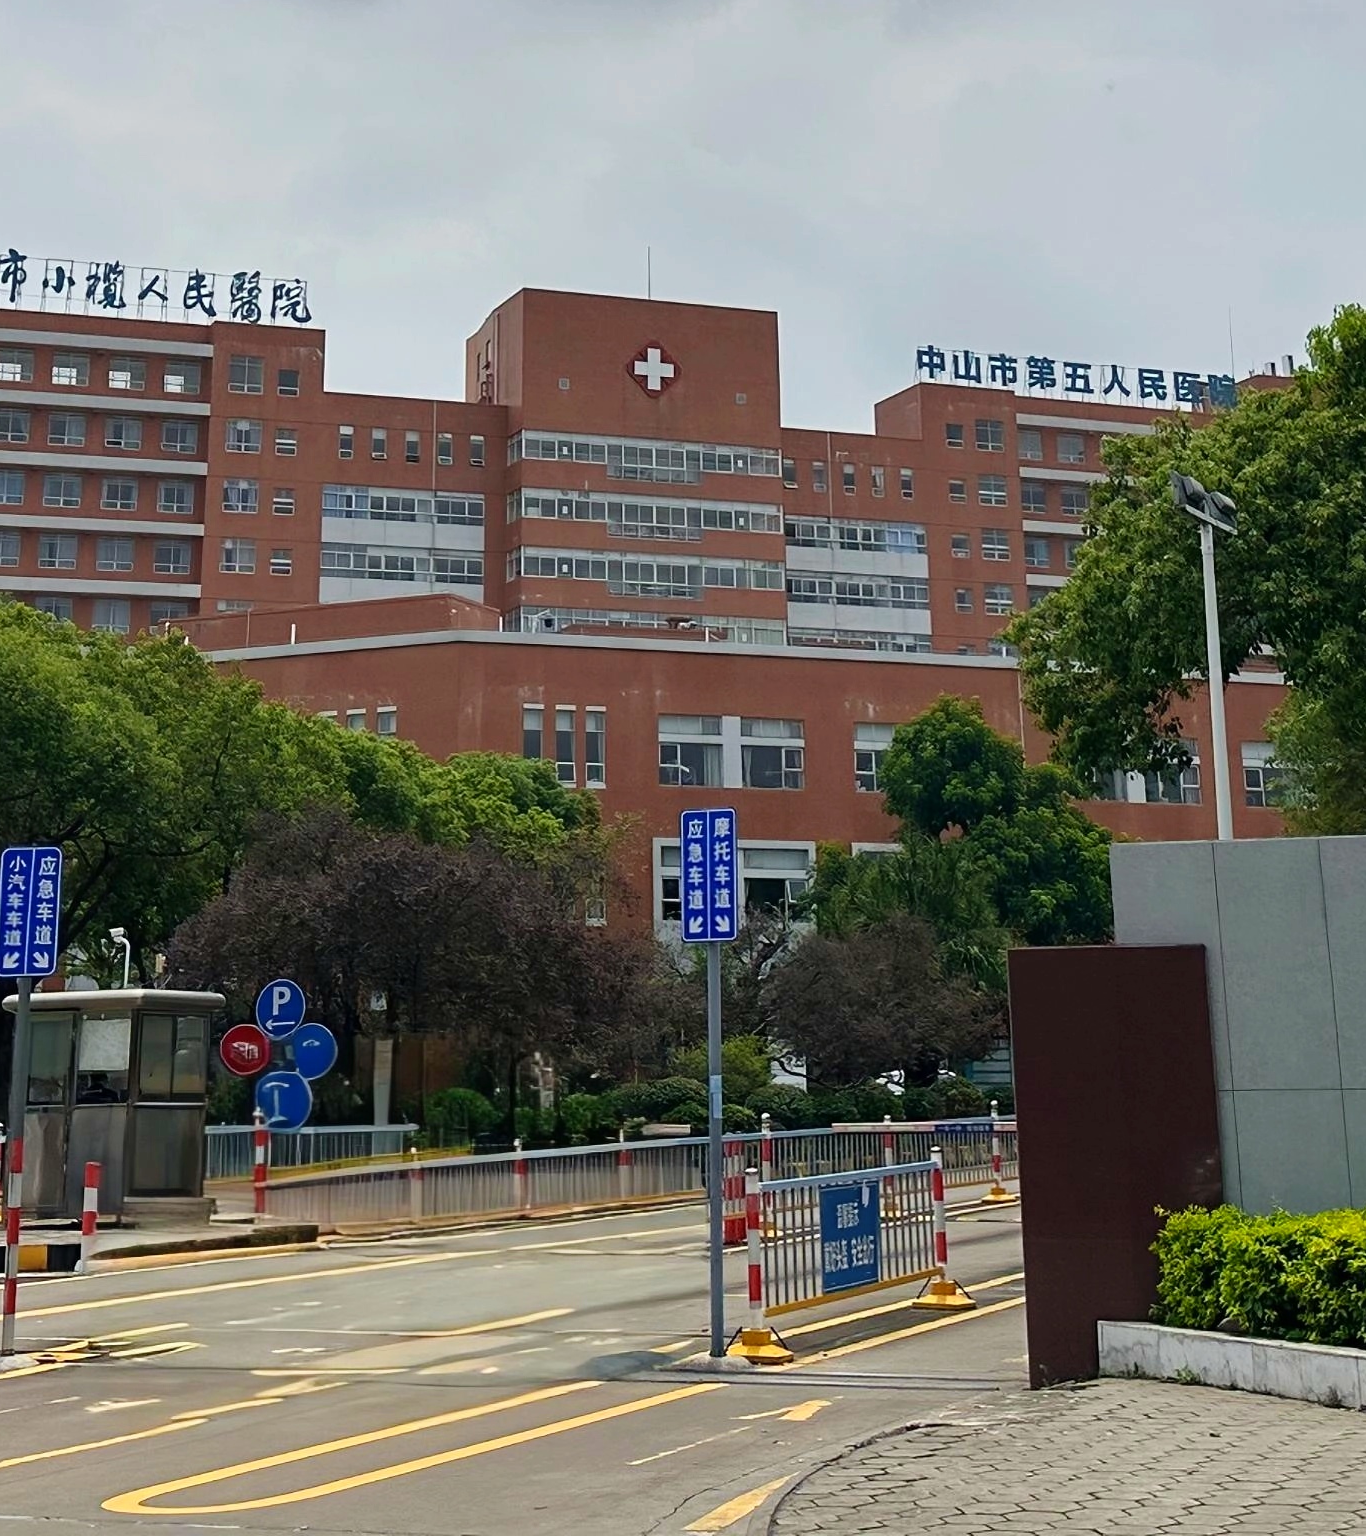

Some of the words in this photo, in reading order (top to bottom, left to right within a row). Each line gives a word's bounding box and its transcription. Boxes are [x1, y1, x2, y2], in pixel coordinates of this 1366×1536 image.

[916, 344, 1236, 408] 中山市第五人民医院
[4, 855, 26, 946] 小汽车车道
[34, 856, 57, 945] 应急车道
[687, 819, 704, 909] 应急车道
[714, 817, 731, 908] 摩托车道
[272, 986, 291, 1015] P
